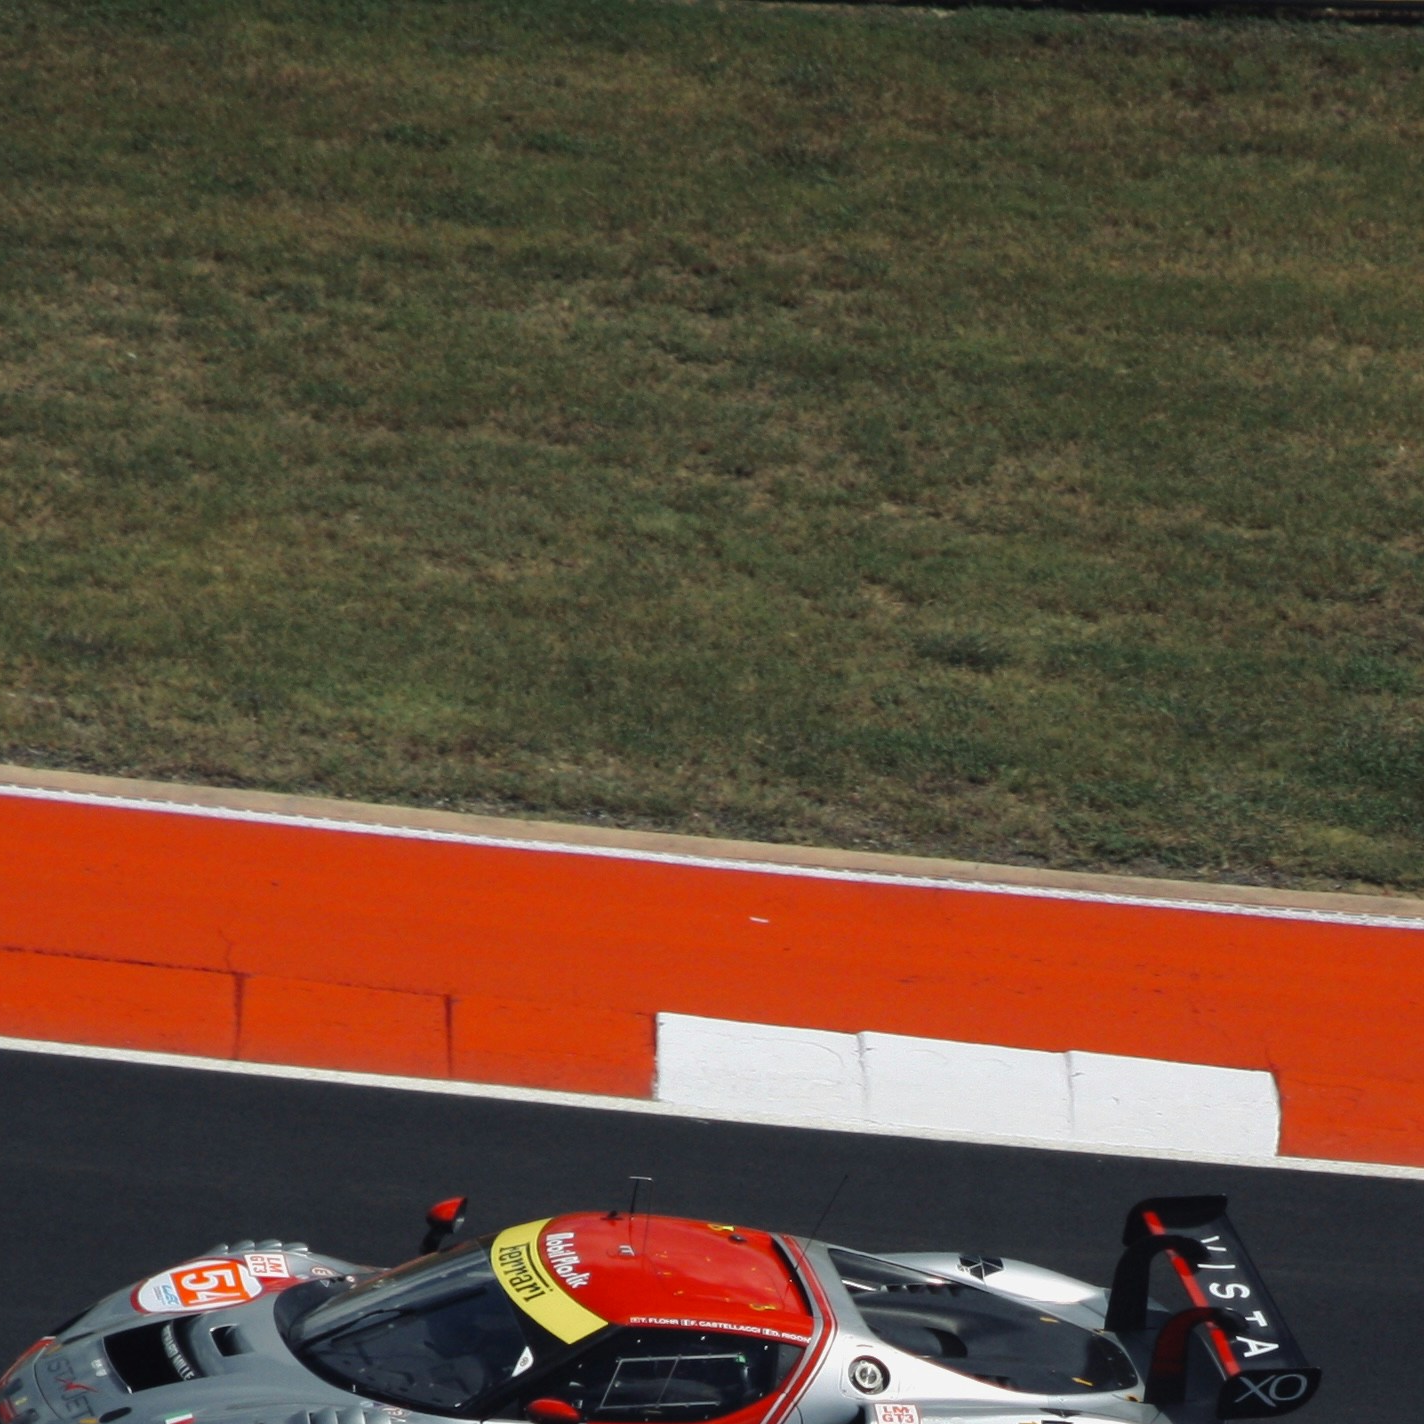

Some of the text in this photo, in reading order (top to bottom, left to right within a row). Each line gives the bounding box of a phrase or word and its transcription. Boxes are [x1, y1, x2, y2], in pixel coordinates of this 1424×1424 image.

[250, 1255, 267, 1274] GT3
[267, 1256, 285, 1274] LM
[499, 1243, 554, 1302] Ferrari
[180, 1268, 241, 1304] 54
[1197, 1235, 1279, 1358] VISTA
[1234, 1373, 1308, 1408] XO
[882, 1413, 915, 1424] GT3
[883, 1406, 910, 1414] LM
